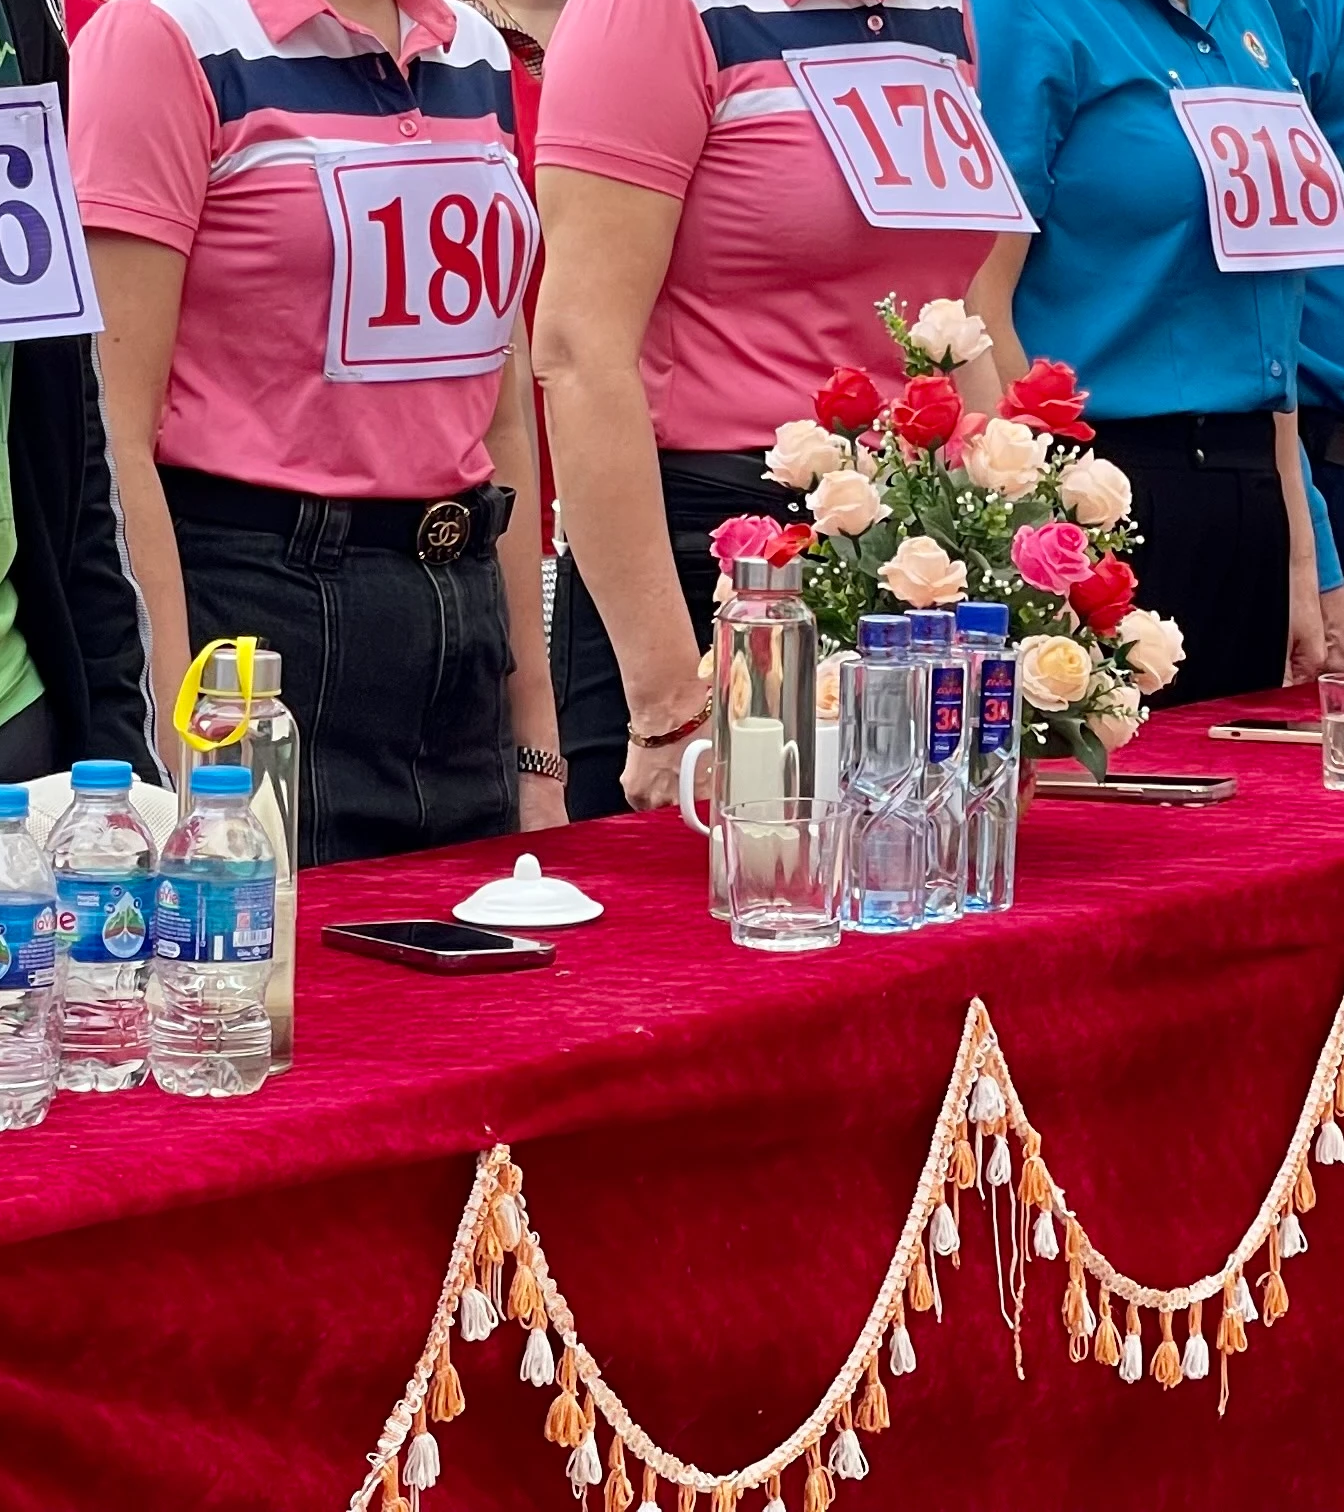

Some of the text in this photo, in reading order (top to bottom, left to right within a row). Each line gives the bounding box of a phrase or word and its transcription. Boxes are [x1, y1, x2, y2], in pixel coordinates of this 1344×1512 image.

[834, 84, 994, 191] 179
[1210, 124, 1339, 230] 318
[367, 192, 527, 327] 180
[935, 707, 961, 731] 3A
[983, 698, 1011, 722] 3A
